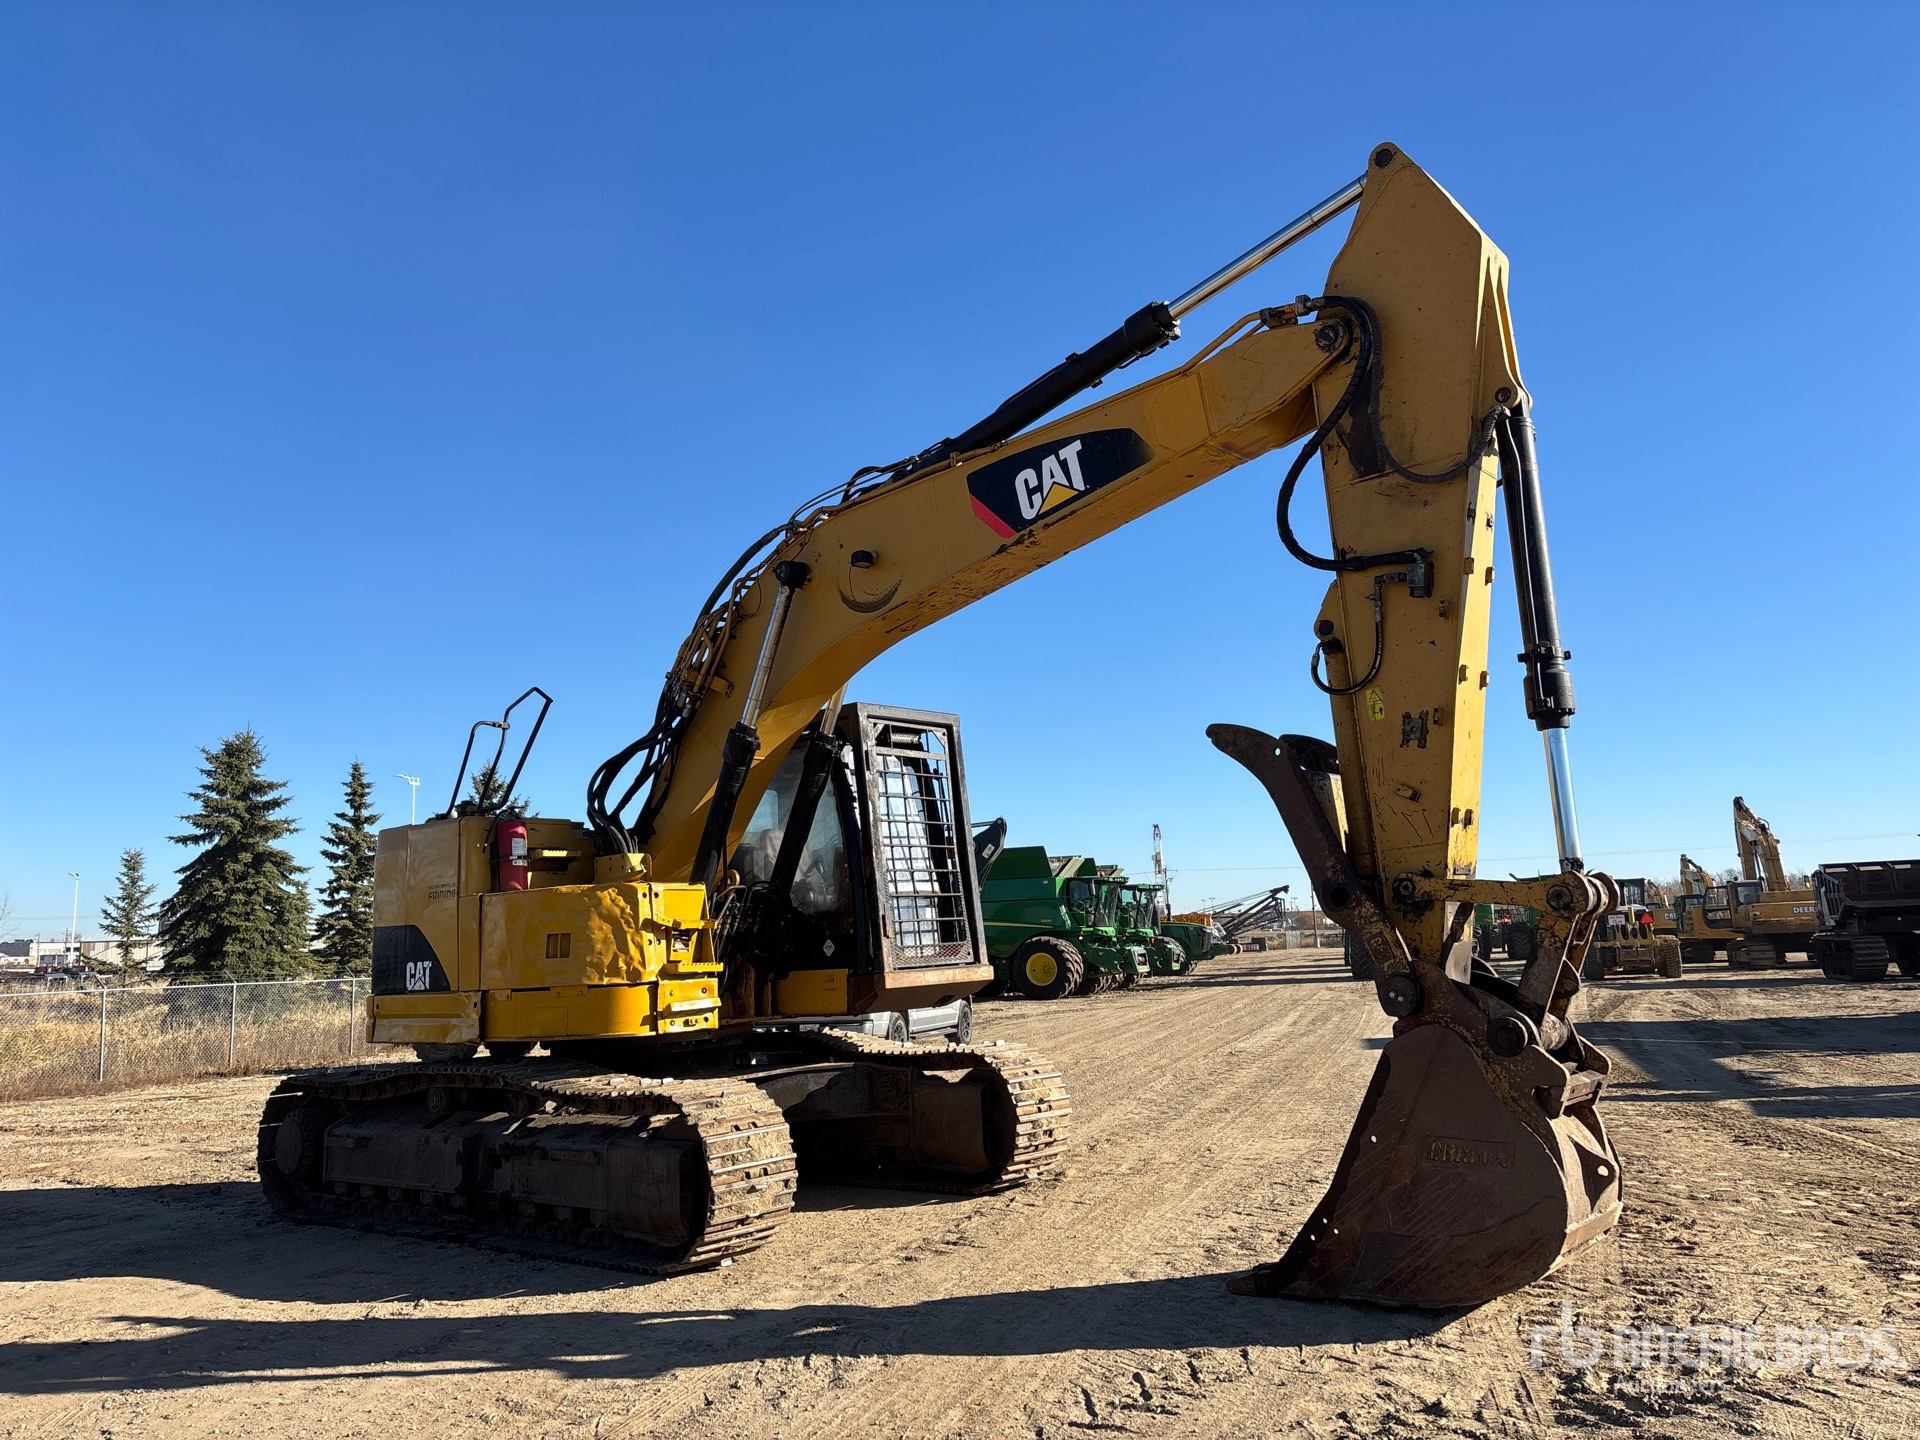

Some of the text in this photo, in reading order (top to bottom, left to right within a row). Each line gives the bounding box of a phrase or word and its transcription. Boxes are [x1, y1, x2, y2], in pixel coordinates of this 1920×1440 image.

[1015, 440, 1085, 519] CAT
[1793, 906, 1817, 914] DEER
[406, 961, 433, 991] CAT
